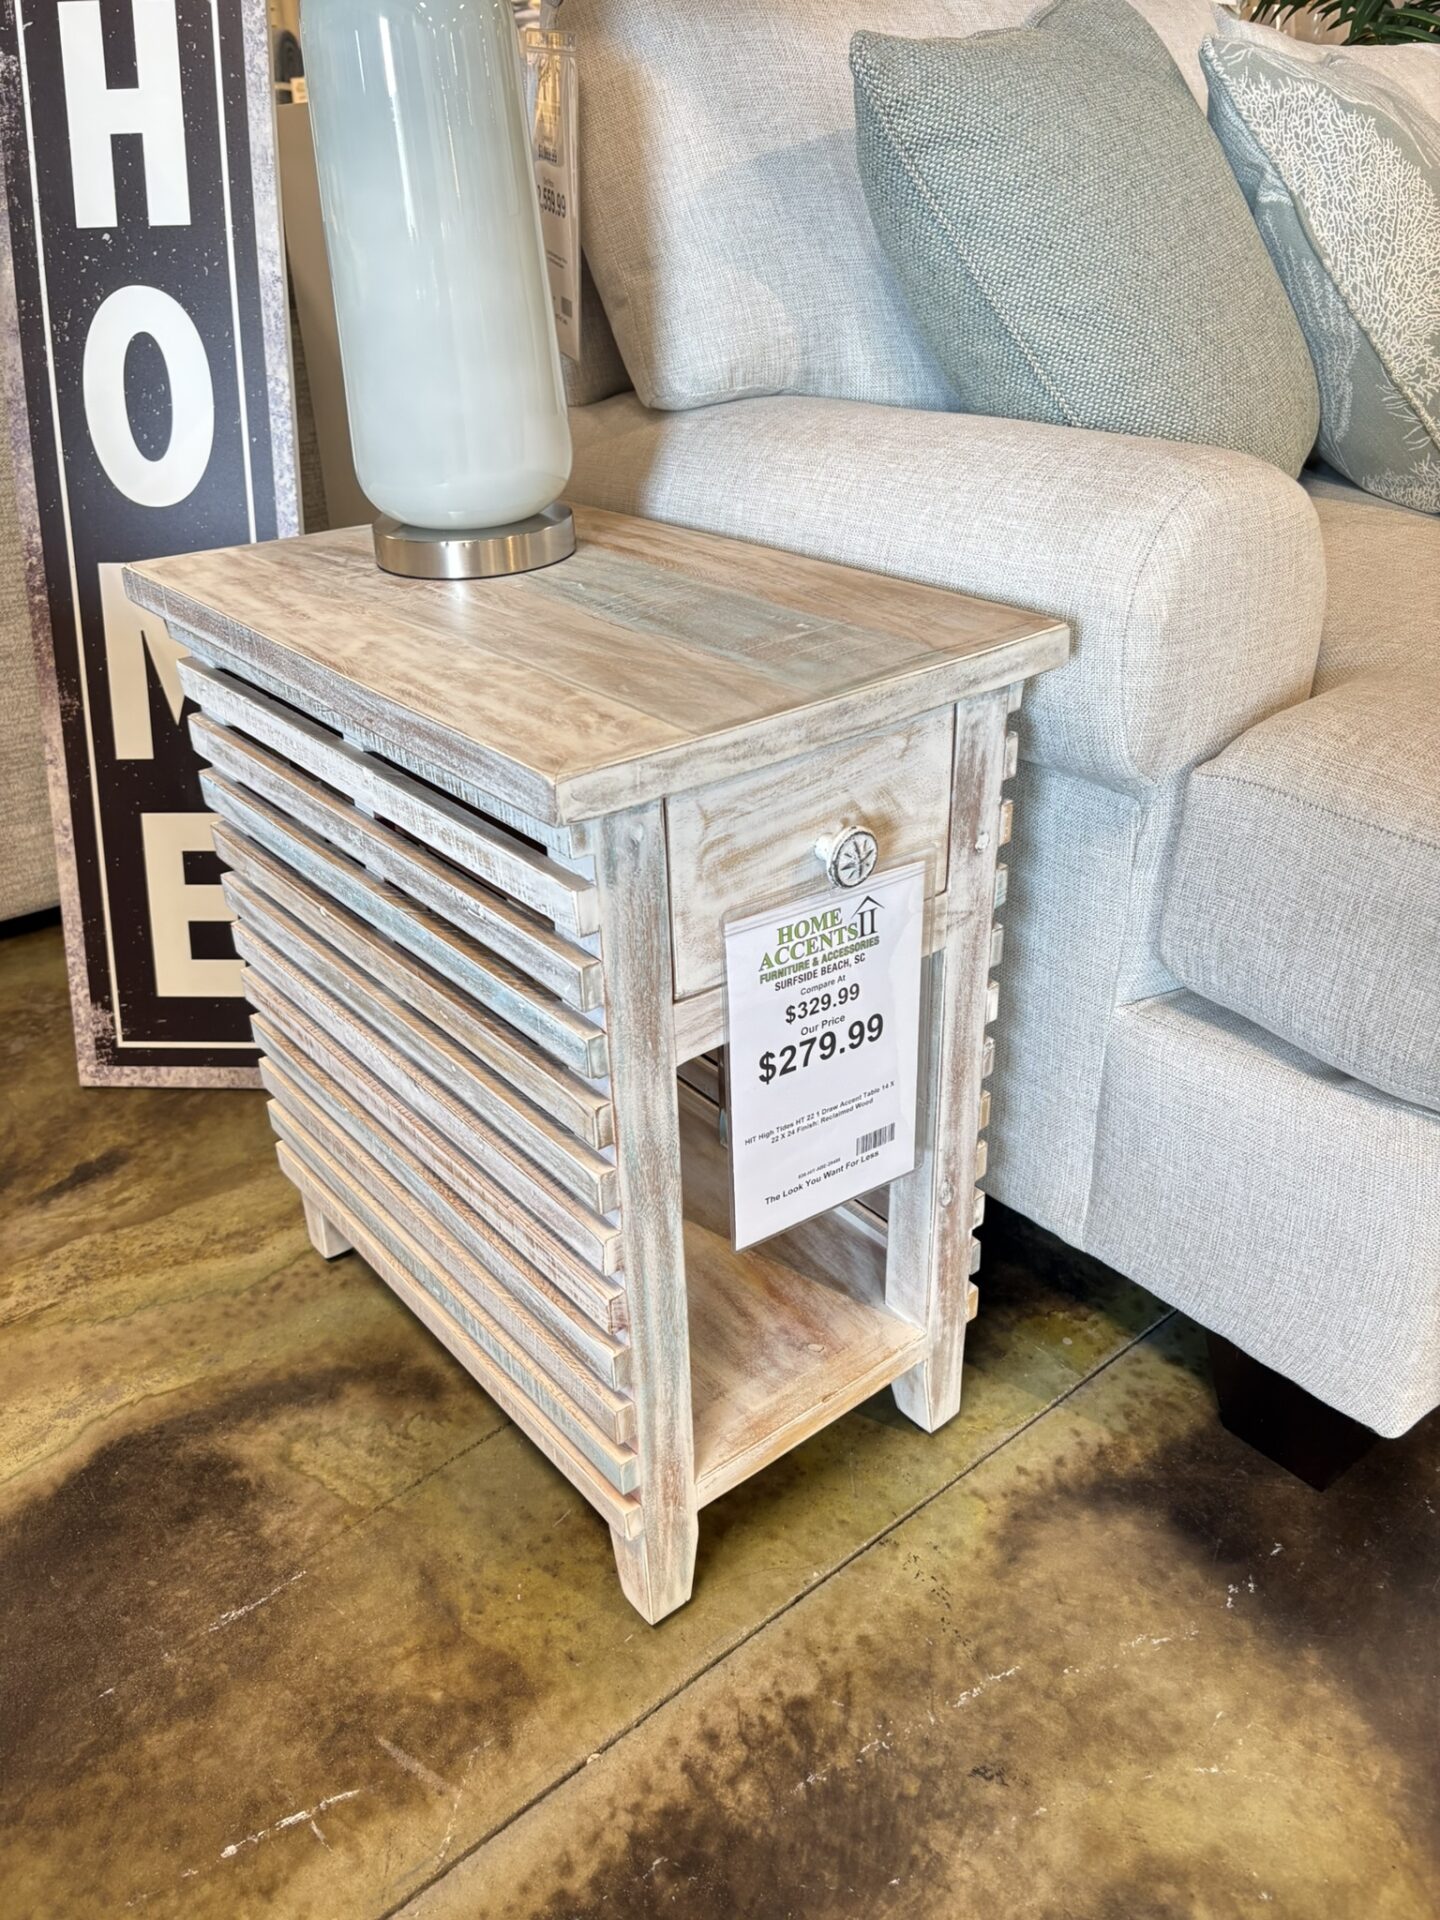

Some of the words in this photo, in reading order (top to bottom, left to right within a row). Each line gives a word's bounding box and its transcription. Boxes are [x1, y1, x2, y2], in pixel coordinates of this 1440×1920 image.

[758, 922, 859, 972] ACCENTS
[777, 907, 843, 946] HOME
[759, 959, 810, 984] FURNITURE
[812, 957, 819, 967] &
[821, 935, 880, 964] ACCESSORIES
[775, 969, 818, 992] SURFSIDE
[821, 958, 852, 977] BEACH,
[854, 953, 866, 965] SC
[785, 983, 860, 1024] $329.99
[800, 979, 835, 996] Compare
[837, 974, 846, 984] At
[801, 1024, 819, 1036] Our
[821, 1014, 846, 1029] Price
[758, 1013, 884, 1085] $279.99
[745, 1136, 757, 1146] HIT
[758, 1129, 775, 1142] High
[776, 1121, 794, 1134] Tides
[796, 1116, 805, 1126] HT
[806, 1113, 815, 1122] 22
[821, 1104, 838, 1116] Draw
[839, 1094, 862, 1108] Accent
[863, 1087, 880, 1099] Table
[882, 1083, 889, 1091] 14
[889, 1080, 895, 1088] X
[771, 1135, 780, 1144] 22
[781, 1132, 787, 1140] X
[787, 1128, 796, 1138] 24
[796, 1120, 819, 1134] Finish:
[820, 1106, 854, 1124] Reclaimed
[855, 1097, 874, 1110] Wood
[764, 1194, 780, 1205] The
[782, 1184, 803, 1198] Look
[805, 1175, 821, 1187] You
[823, 1165, 844, 1180] Want
[846, 1158, 859, 1170] For
[860, 1150, 879, 1163] Less
